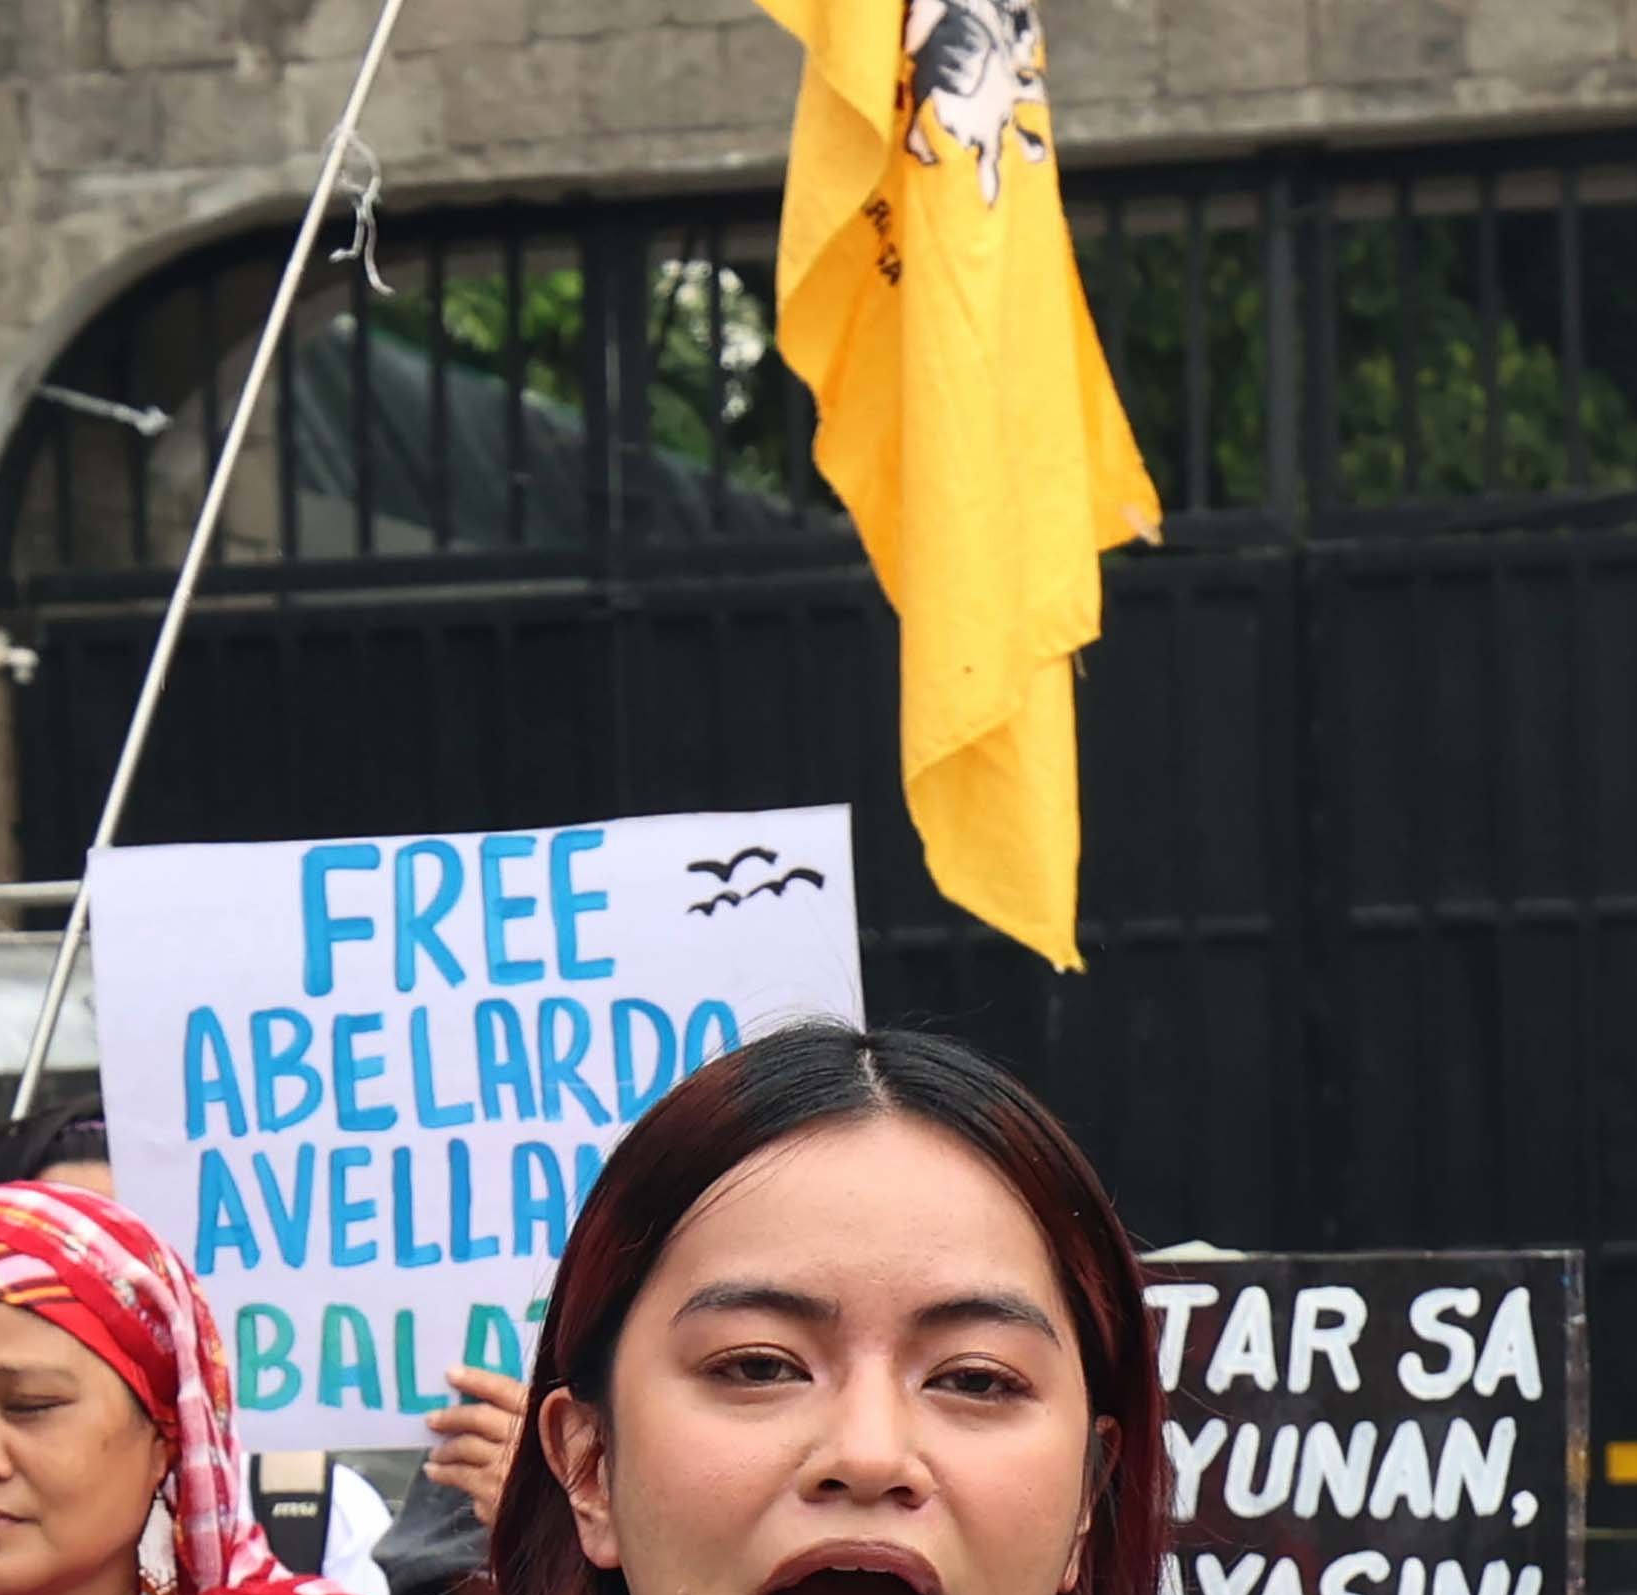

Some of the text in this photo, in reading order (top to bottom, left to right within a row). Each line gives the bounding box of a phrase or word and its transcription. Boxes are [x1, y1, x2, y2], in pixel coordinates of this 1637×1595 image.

[301, 829, 616, 997] FREE
[235, 1298, 550, 1414] BALA
[1397, 1286, 1543, 1400] SA
